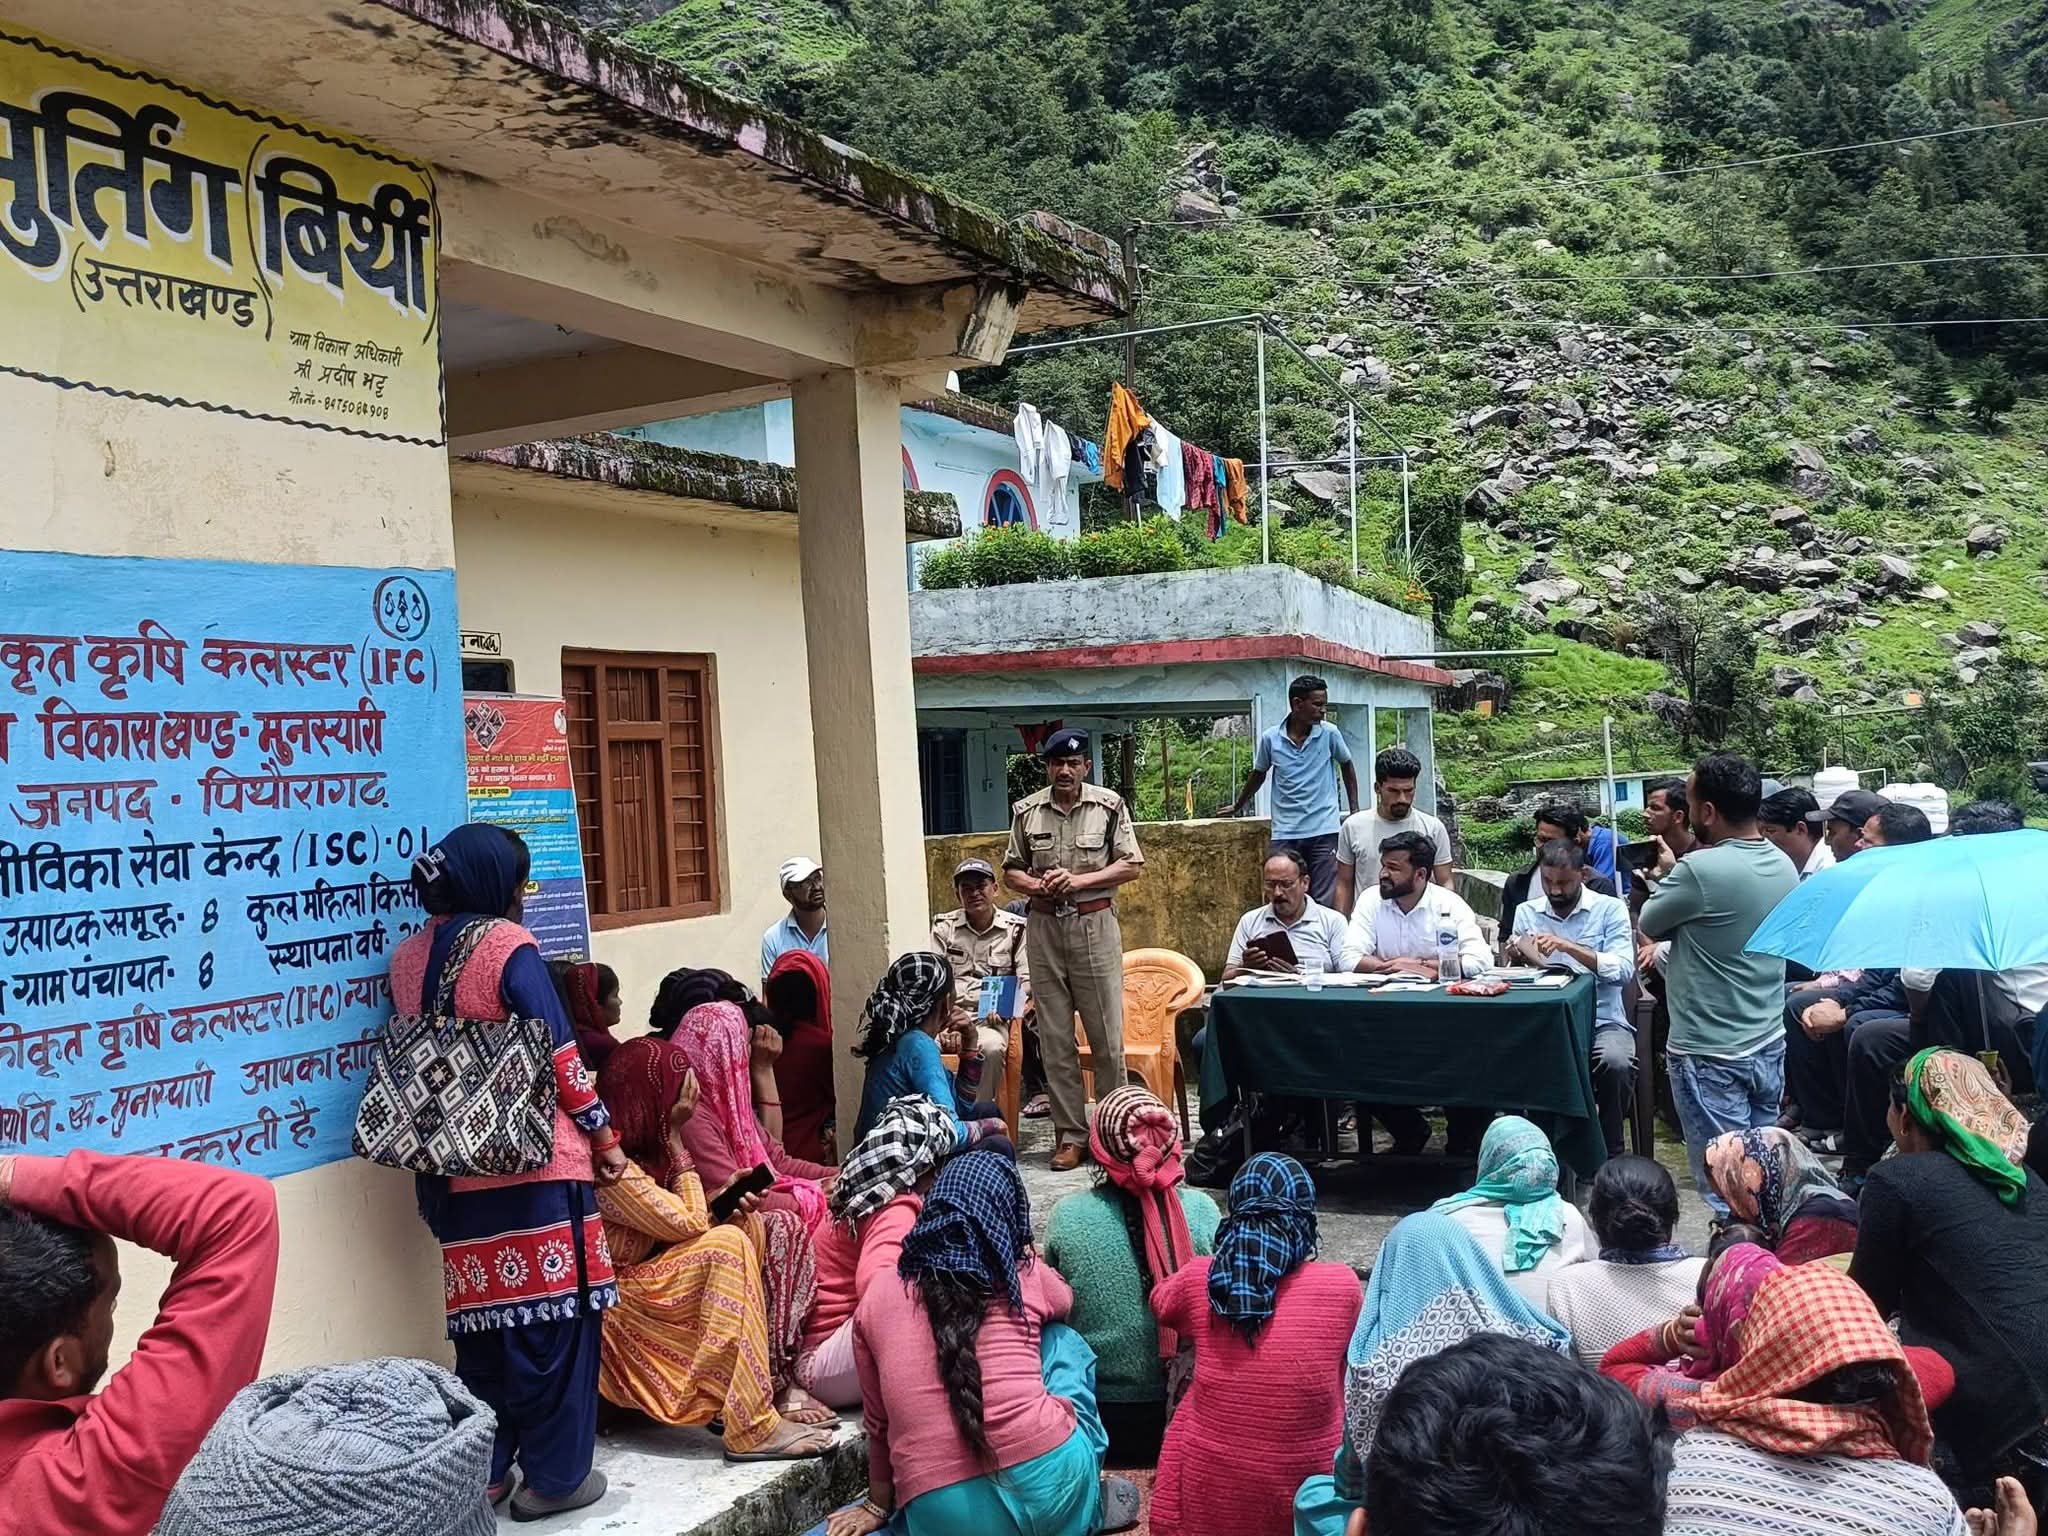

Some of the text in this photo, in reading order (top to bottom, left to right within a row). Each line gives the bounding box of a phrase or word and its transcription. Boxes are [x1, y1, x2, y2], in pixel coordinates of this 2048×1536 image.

[71, 241, 273, 342] (उत्तराखण्ड)
[314, 331, 352, 356] विकास
[354, 340, 403, 367] अधिकारी
[318, 363, 357, 388] प्रदीप
[84, 619, 189, 700] कृषि
[201, 638, 355, 688] कलस्टर
[360, 634, 438, 697] (IFC)
[252, 696, 387, 766] मुनस्यारी
[9, 779, 158, 829] जनपद
[128, 829, 196, 888] सेवा
[201, 827, 282, 878] केन्द्र
[201, 898, 218, 933] 8
[246, 891, 298, 941] कुल
[300, 877, 367, 923] महिला
[12, 970, 69, 1006] ग्राम
[199, 951, 214, 990] 8
[265, 932, 354, 975] स्थापना
[96, 1003, 167, 1070] कृषि
[168, 992, 284, 1043] कलस्टर
[286, 980, 341, 1028] (IFC)
[240, 1047, 337, 1096] आपका
[285, 1096, 320, 1149] है
